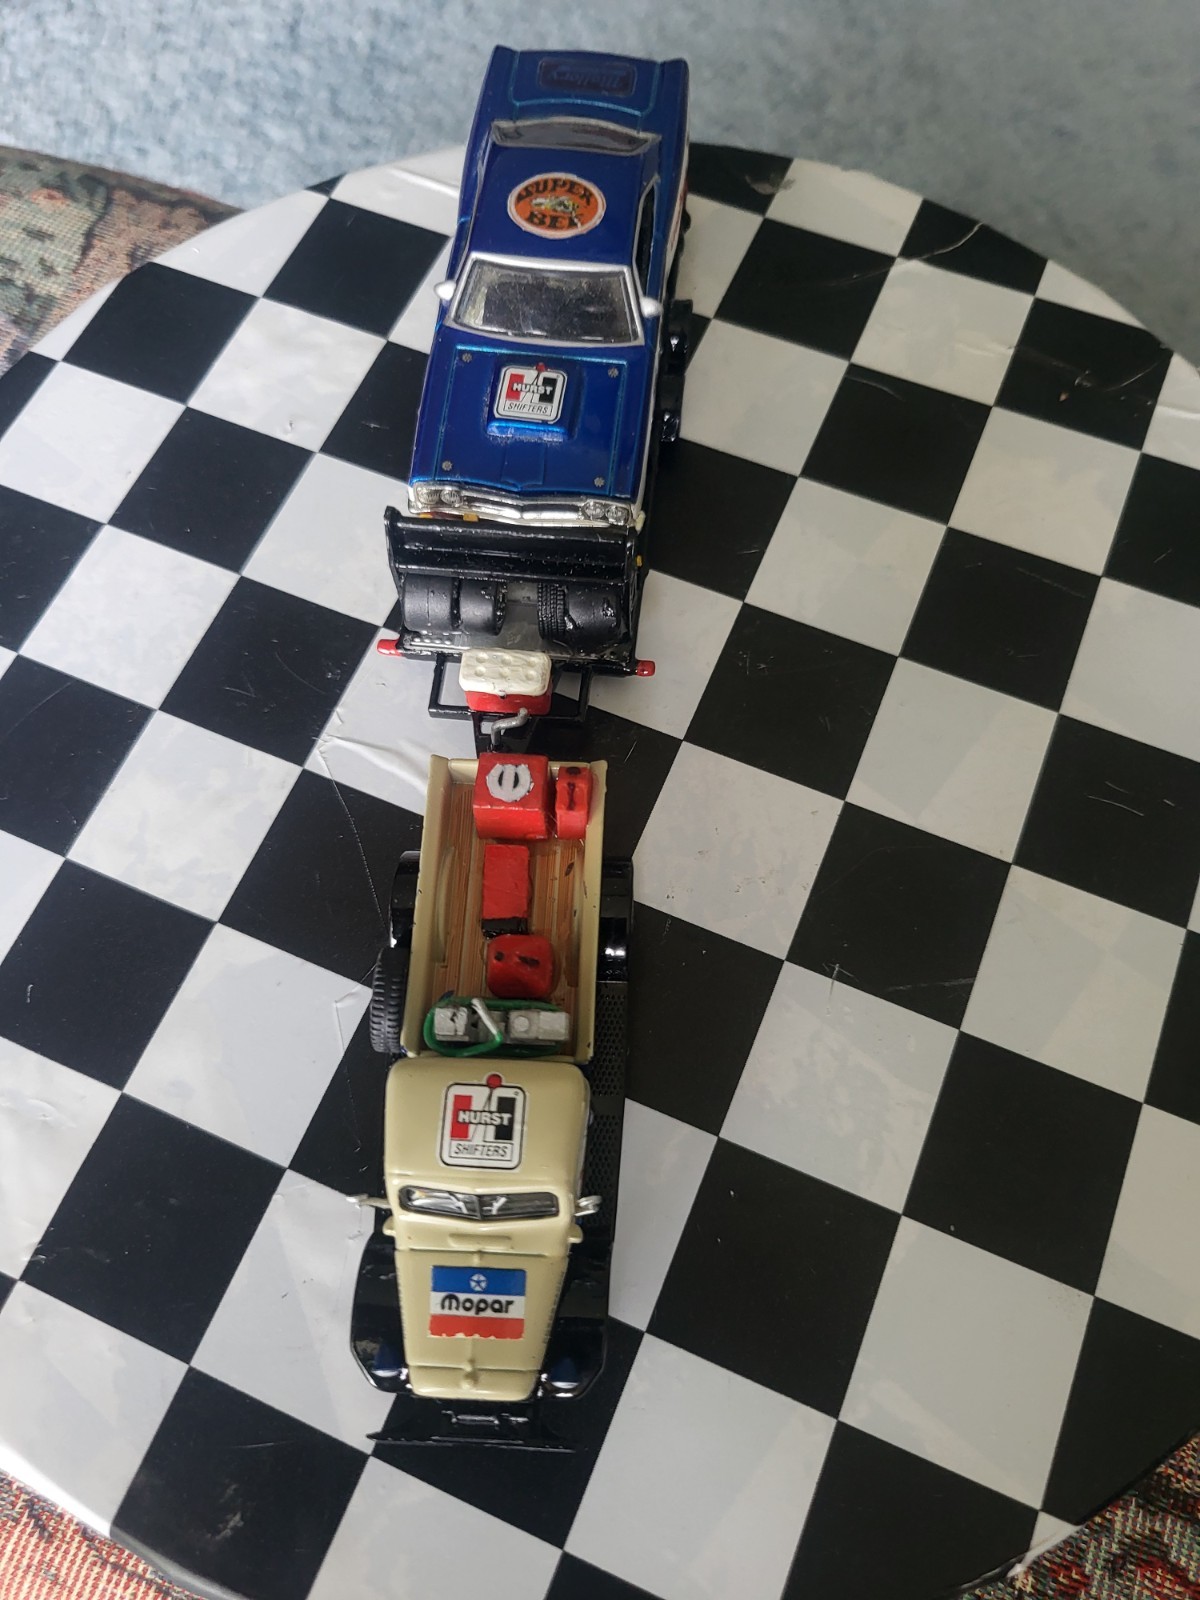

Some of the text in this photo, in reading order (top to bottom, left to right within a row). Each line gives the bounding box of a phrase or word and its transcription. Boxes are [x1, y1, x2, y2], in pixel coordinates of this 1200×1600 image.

[516, 178, 592, 206] SUPER
[512, 383, 553, 395] HURST
[507, 402, 548, 414] SHIFTERS
[457, 1110, 512, 1126] HURST
[454, 1143, 508, 1157] SHIFTERS
